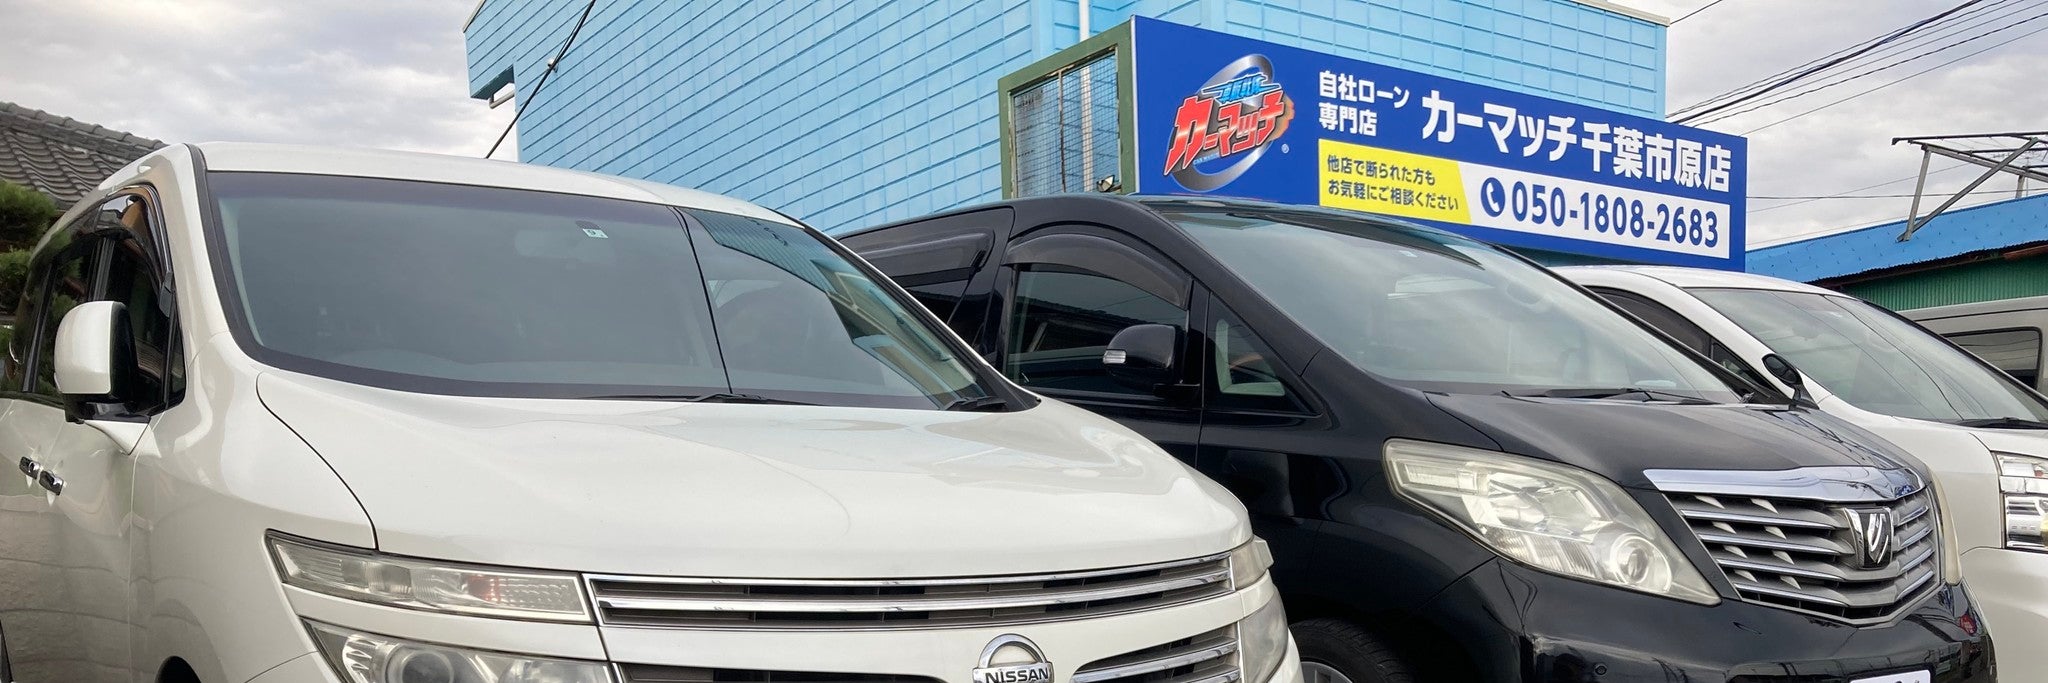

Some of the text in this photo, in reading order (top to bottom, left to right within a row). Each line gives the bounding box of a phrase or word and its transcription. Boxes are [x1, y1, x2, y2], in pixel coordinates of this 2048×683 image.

[1319, 70, 1410, 109] 自社ローン
[1163, 90, 1285, 175] カーマッチ
[1318, 102, 1377, 136] 専門店
[1327, 154, 1436, 186] 他店で断られた方も
[1328, 179, 1459, 210] お気軽にご相談ください
[1511, 181, 1719, 249] 050-1808-2683
[985, 667, 1049, 683] NISSAN
